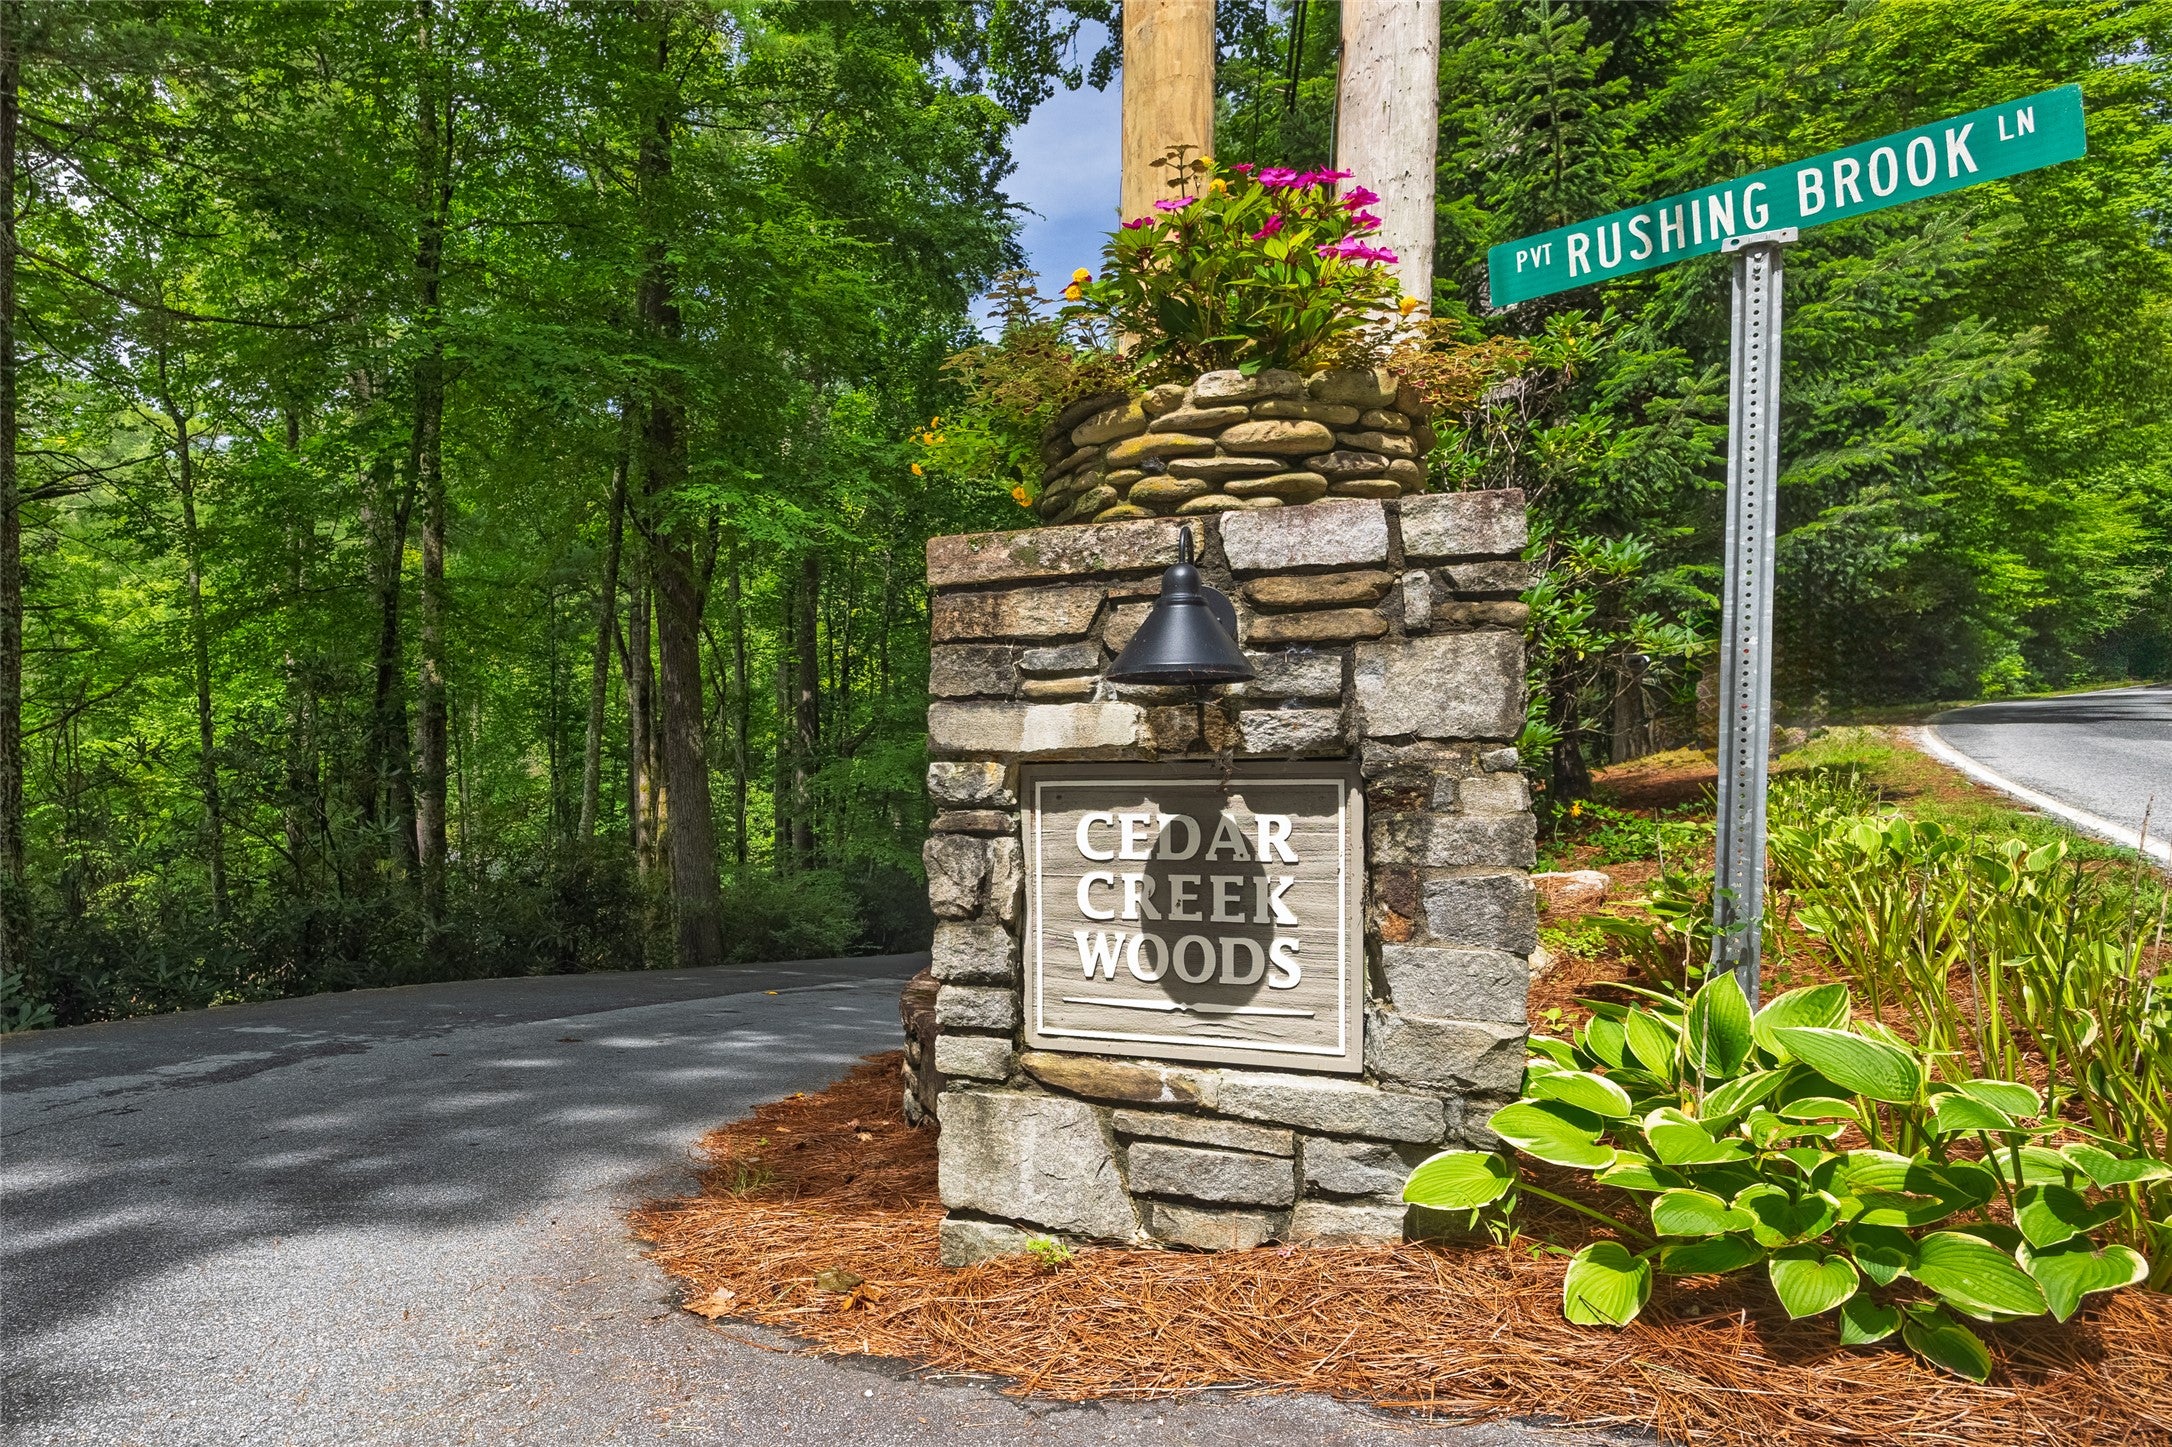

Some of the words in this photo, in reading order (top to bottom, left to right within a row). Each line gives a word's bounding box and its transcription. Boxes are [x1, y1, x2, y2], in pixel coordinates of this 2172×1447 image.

[1515, 242, 1552, 273] PVT
[1567, 181, 1770, 278] RUSHING
[1798, 123, 1978, 218] BROOK
[1998, 105, 2036, 142] LN
[1076, 812, 1299, 863] CEDAR
[1076, 871, 1299, 925] CREEK
[1073, 930, 1301, 989] WOODS
